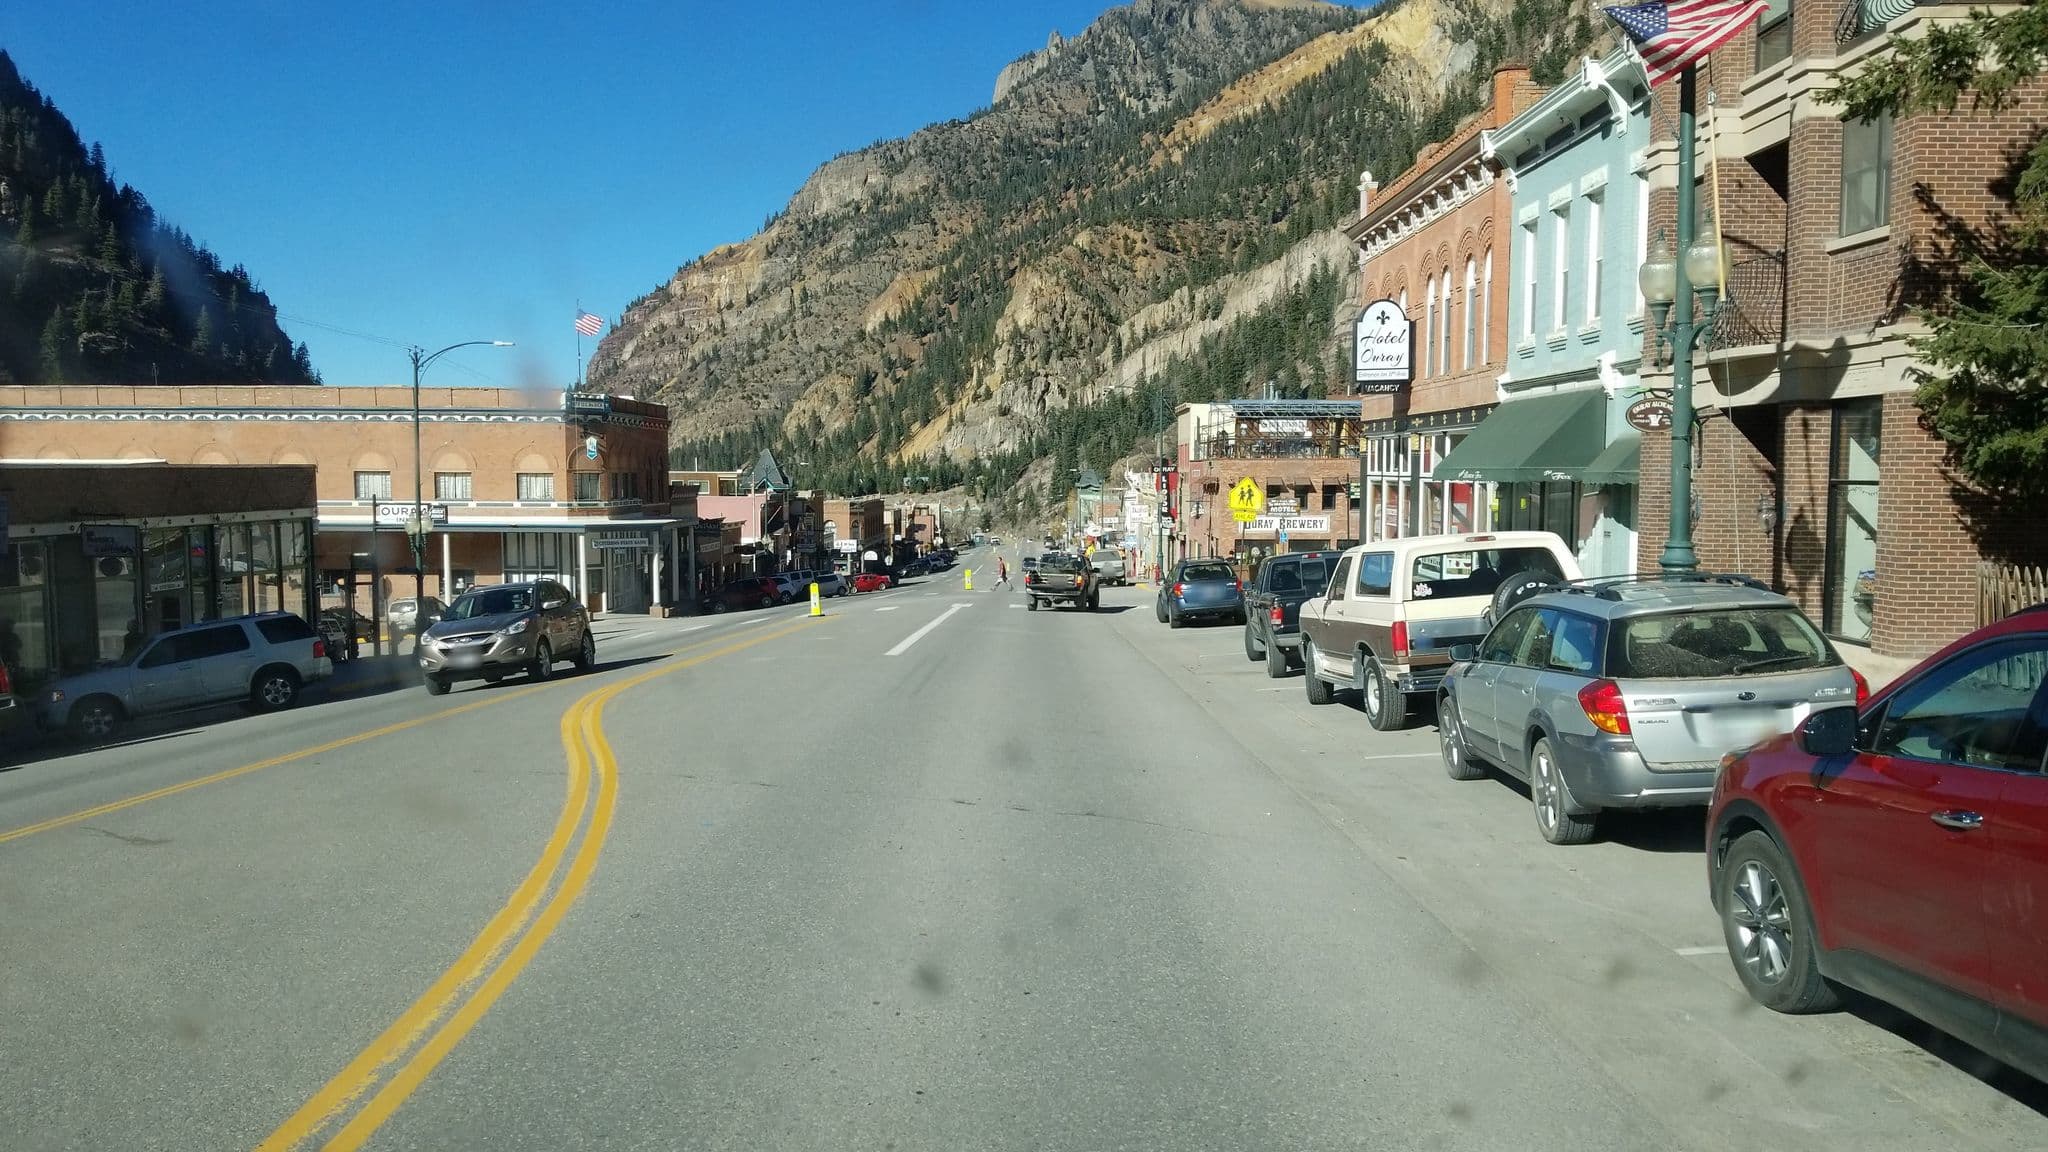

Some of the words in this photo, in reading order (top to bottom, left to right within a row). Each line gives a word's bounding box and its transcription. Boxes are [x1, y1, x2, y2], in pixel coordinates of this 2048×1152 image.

[1360, 327, 1407, 347] Hotel
[1361, 348, 1404, 366] Ouray
[1365, 384, 1400, 393] VACANCY
[1279, 519, 1324, 529] BREWERY
